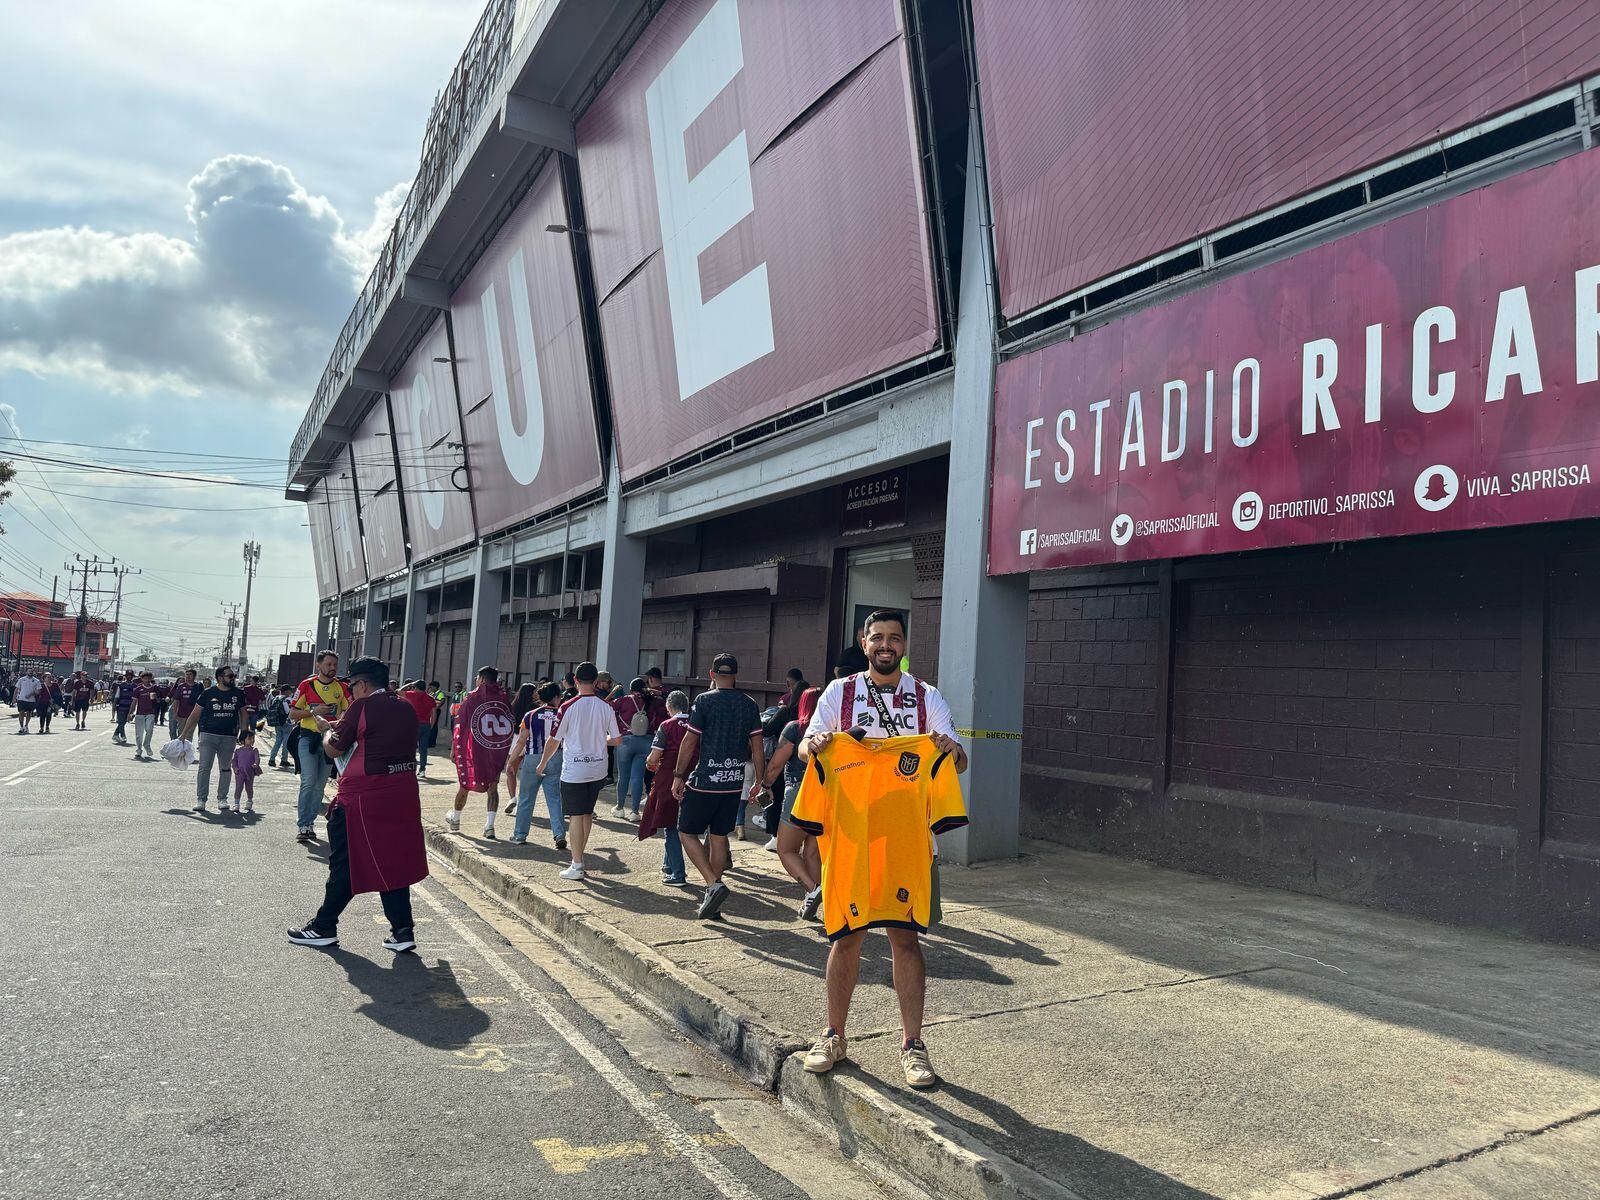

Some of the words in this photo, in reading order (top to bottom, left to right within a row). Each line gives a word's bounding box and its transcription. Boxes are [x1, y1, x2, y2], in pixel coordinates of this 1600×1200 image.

[1024, 357, 1261, 490] ESTADIO
[847, 479, 888, 500] ACCESO
[893, 476, 899, 489] 2
[1466, 464, 1591, 498] VIVA_SAPRISSA
[1268, 489, 1395, 521] DEPORTIVO_SAPRISSA
[870, 687, 885, 713] adidas
[886, 723, 898, 737] adi
[716, 769, 741, 777] STAR
[719, 774, 744, 783] CARS
[834, 760, 866, 774] marathon
